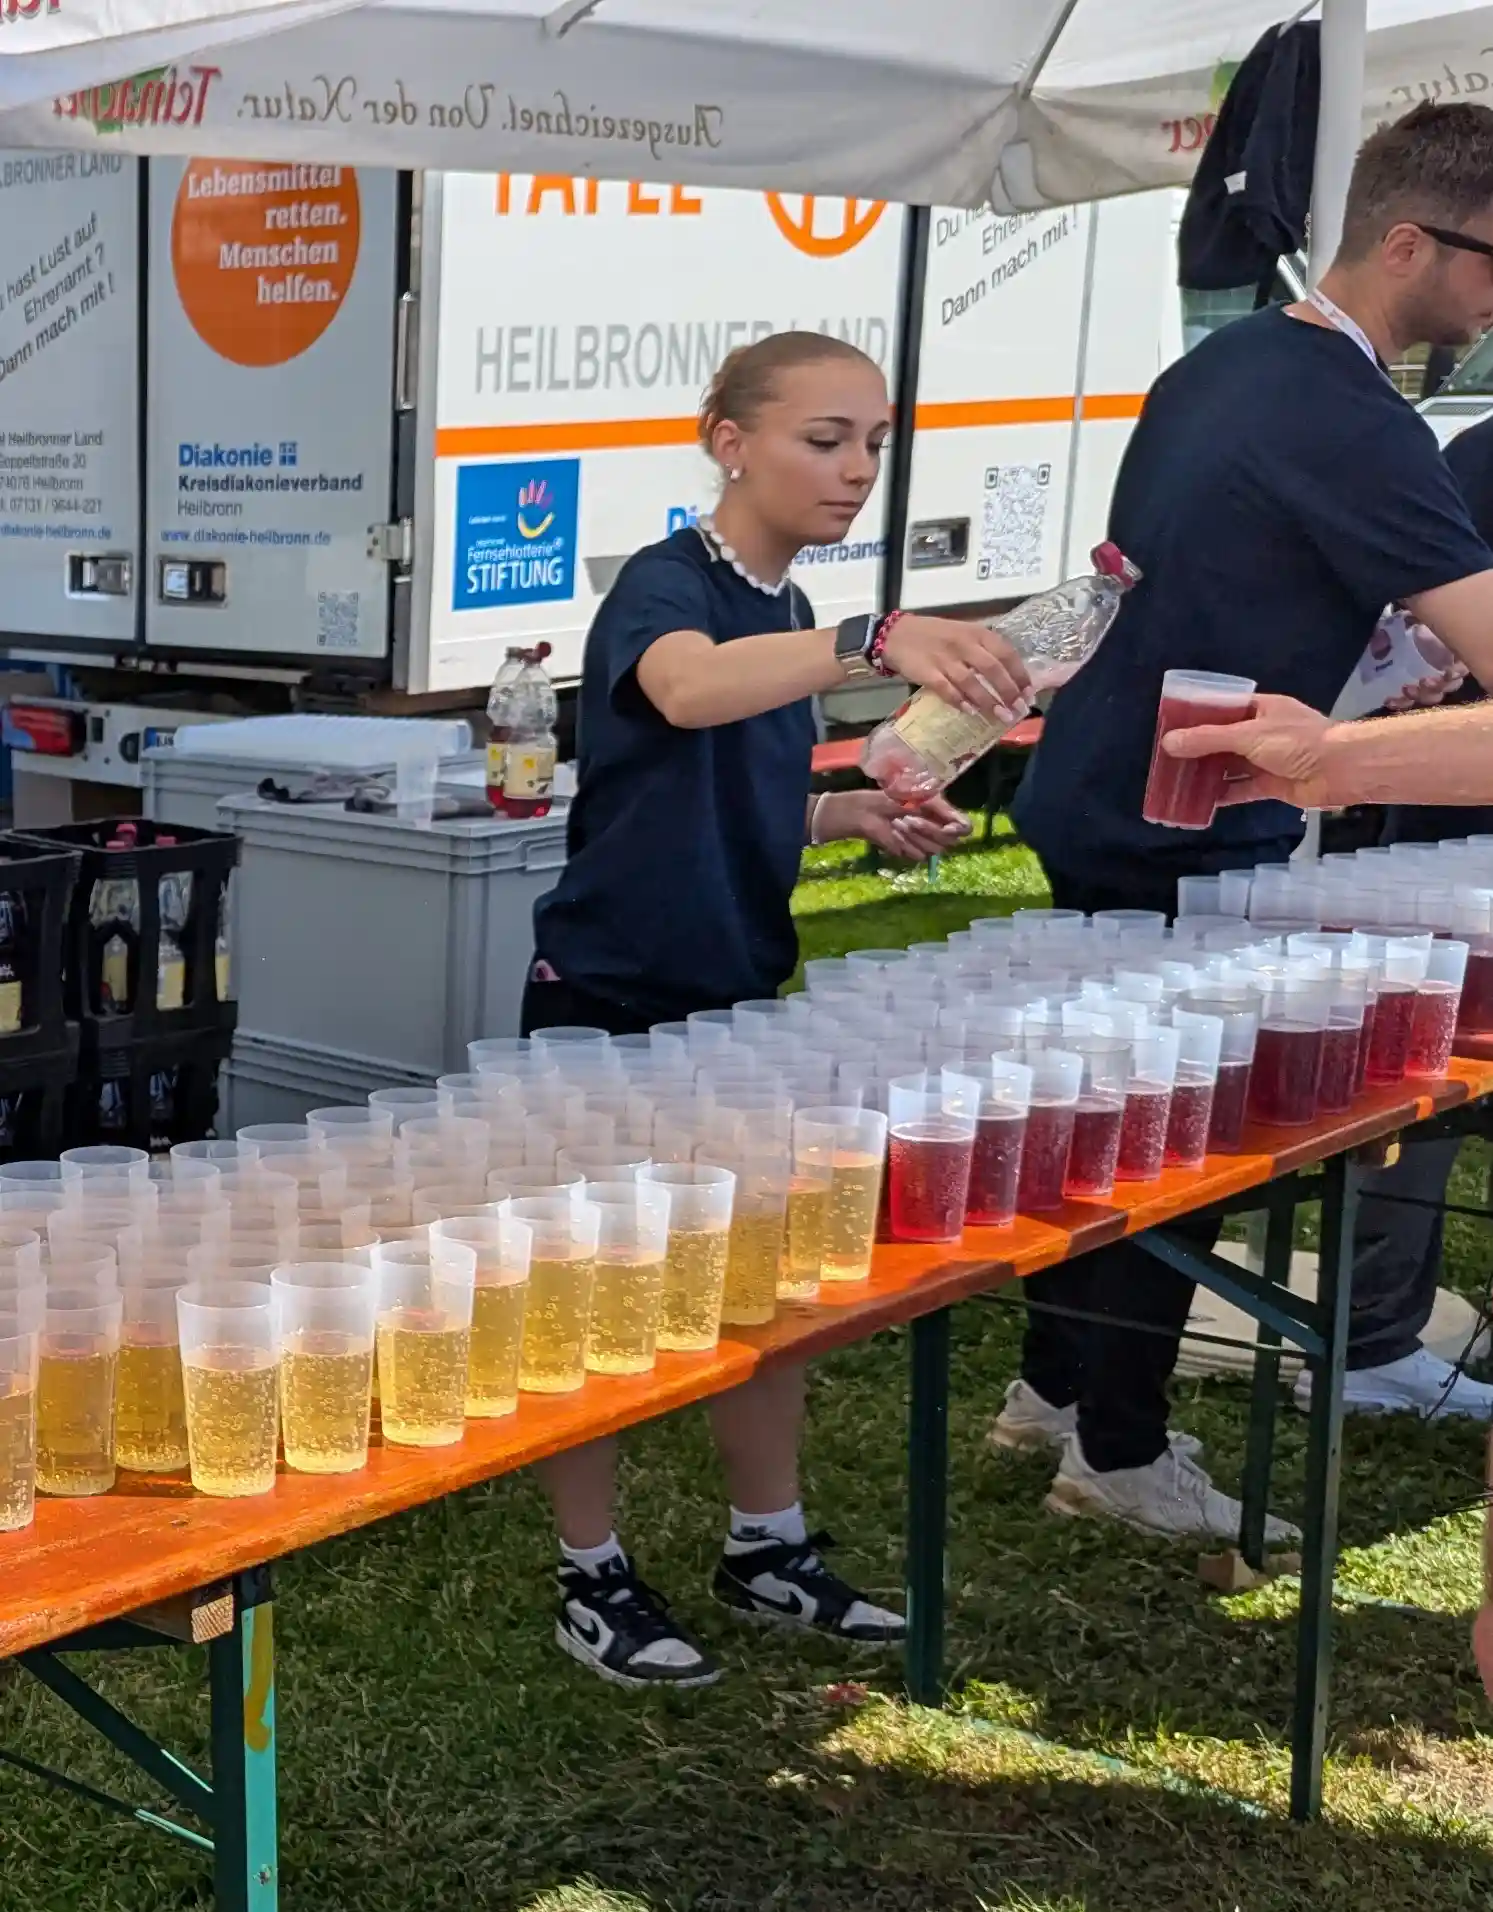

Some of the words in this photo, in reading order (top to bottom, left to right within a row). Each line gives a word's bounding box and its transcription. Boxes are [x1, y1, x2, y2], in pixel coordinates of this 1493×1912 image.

[0, 152, 76, 189] BRONNER
[80, 150, 122, 177] LAND
[187, 163, 342, 199] Lebensmittel
[265, 200, 348, 230] retten.
[936, 212, 960, 247] Du
[6, 264, 36, 303] hast
[39, 236, 71, 276] Lust
[74, 211, 97, 249] auf
[218, 236, 338, 270] Menschen
[942, 279, 986, 325] Dann
[992, 238, 1037, 289] mach
[1042, 213, 1068, 251] mit
[24, 255, 92, 325] Ehrenamt
[257, 272, 339, 305] helfen.
[36, 305, 77, 351] mach
[80, 279, 105, 316] mit
[8, 431, 72, 447] Heilbronner
[74, 429, 103, 446] Land
[178, 443, 273, 467] Diakonie
[33, 476, 84, 491] Heilbronn
[178, 473, 363, 492] Kreisdiakonieverband
[178, 500, 243, 516] Heilbronn
[161, 528, 331, 546] www.diakonie-heilbronn.de
[467, 556, 564, 594] STIFTUNG
